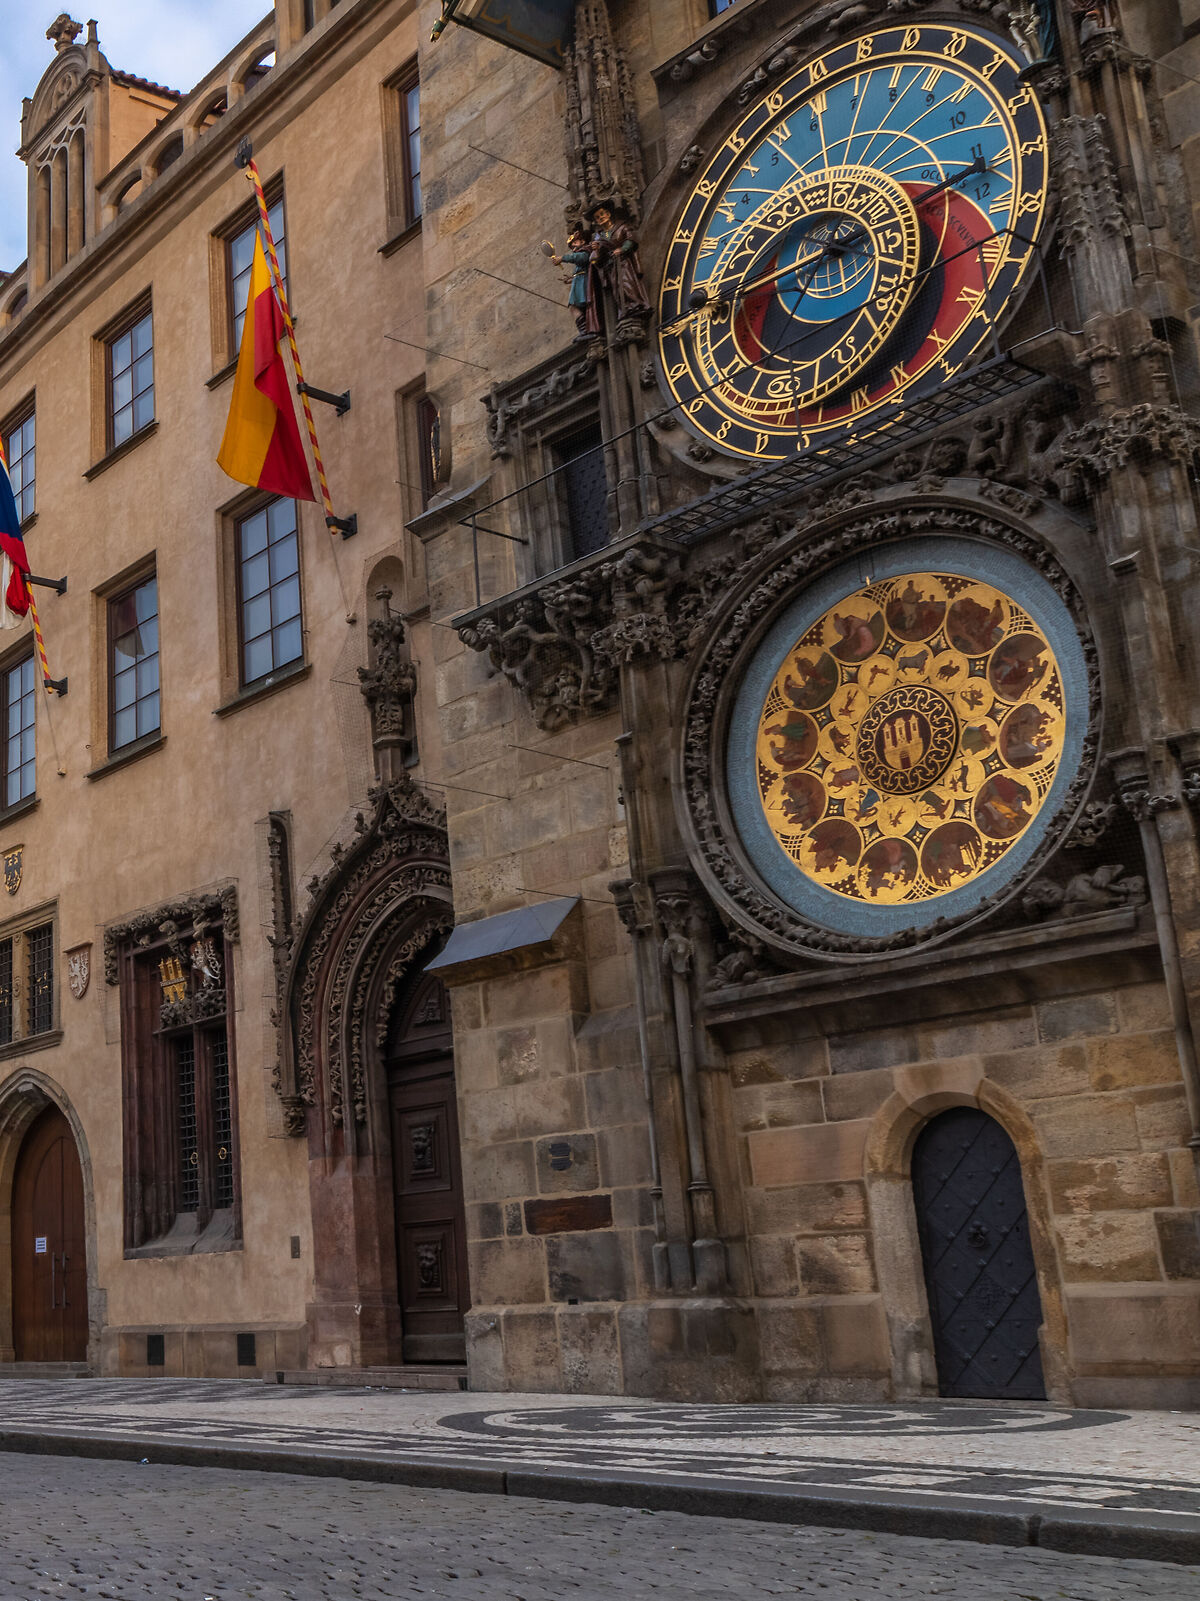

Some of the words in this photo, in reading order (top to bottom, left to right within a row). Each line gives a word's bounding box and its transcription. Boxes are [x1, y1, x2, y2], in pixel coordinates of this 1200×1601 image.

[888, 88, 898, 103] 8
[925, 93, 935, 107] 9
[763, 91, 784, 116] 16
[849, 97, 858, 111] 7
[809, 119, 818, 132] 6
[948, 110, 966, 130] 10
[970, 142, 983, 159] 11
[771, 152, 779, 167] 5
[741, 192, 751, 205] 4
[974, 182, 991, 201] 12
[716, 420, 732, 440] 8
